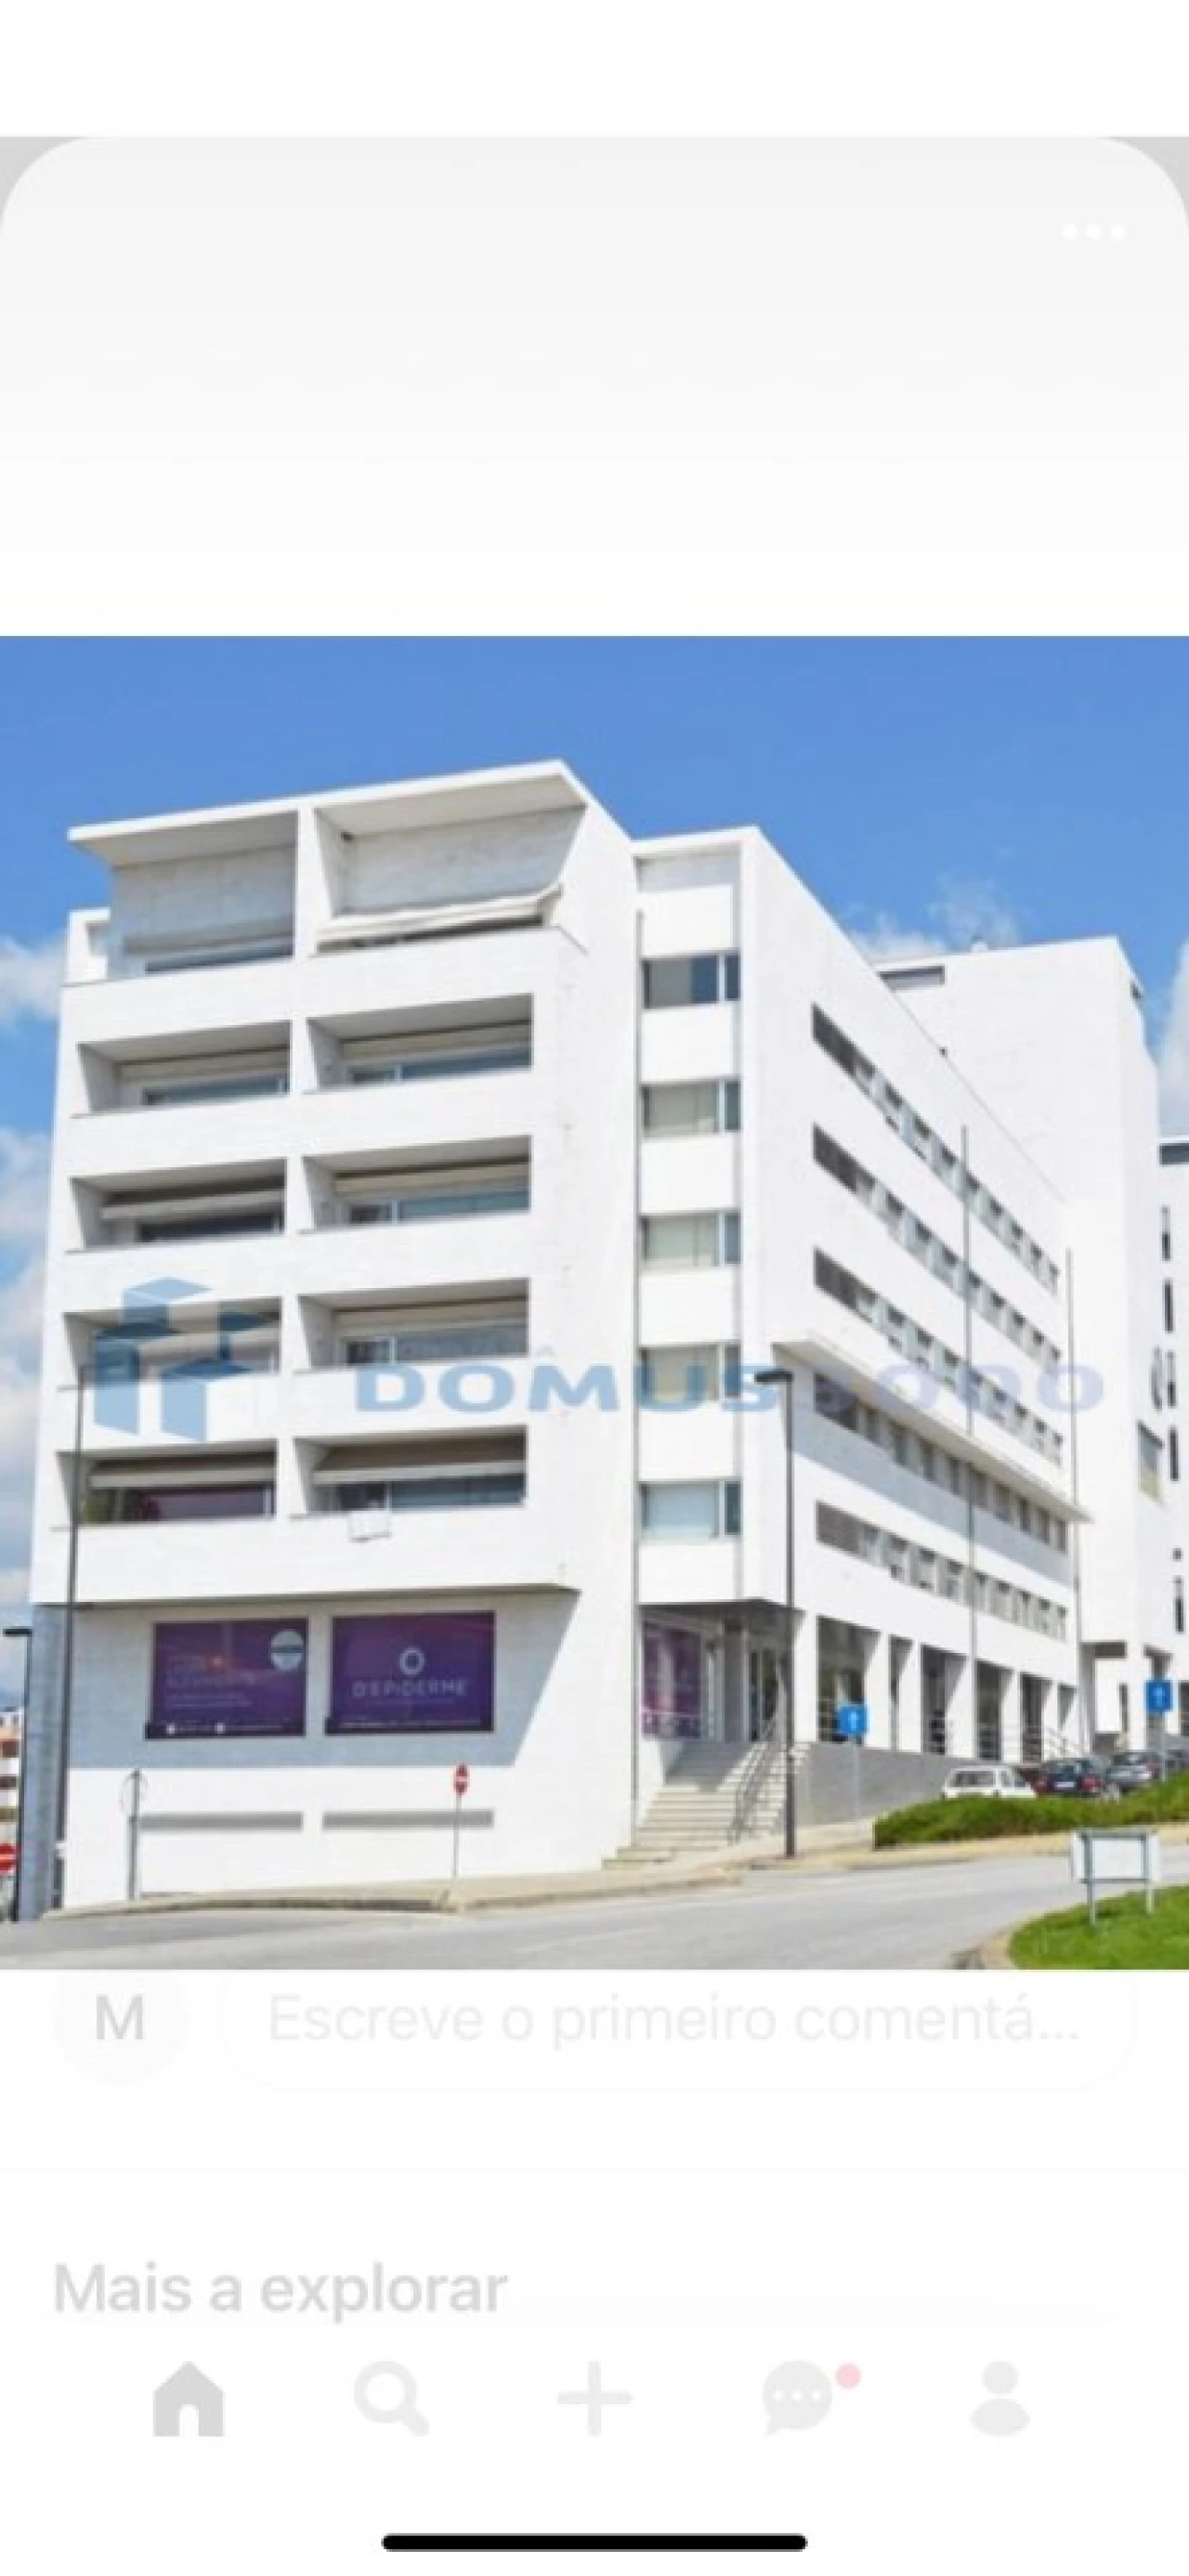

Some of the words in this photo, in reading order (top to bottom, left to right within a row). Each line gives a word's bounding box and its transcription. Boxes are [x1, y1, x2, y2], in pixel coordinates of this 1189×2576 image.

[95, 1993, 144, 2041] M
[269, 1993, 484, 2042] Escreve
[501, 2005, 534, 2041] o
[553, 1993, 777, 2051] primeiro
[54, 2261, 191, 2313] Mais
[209, 2274, 242, 2313] a
[260, 2261, 509, 2325] explorar
